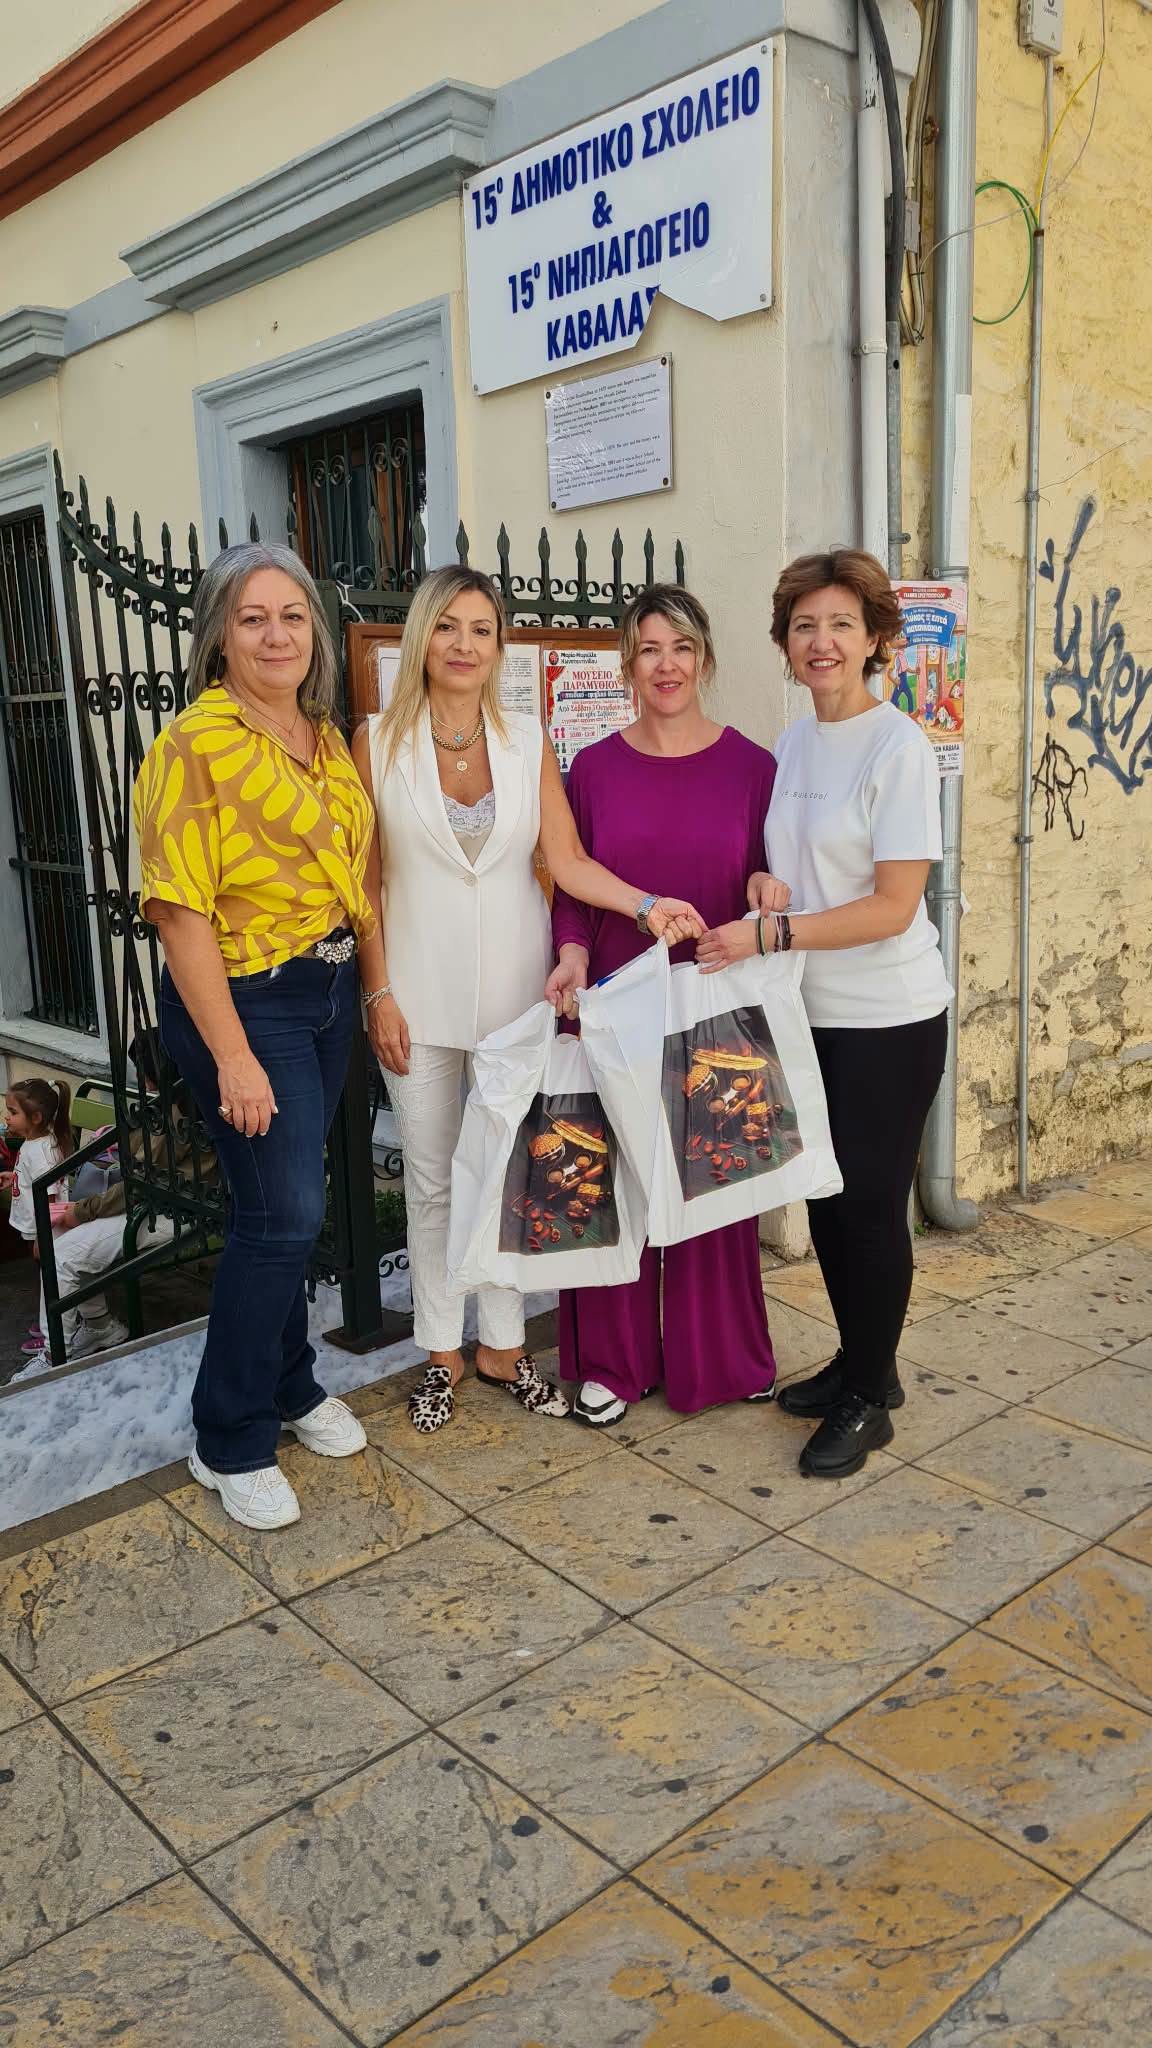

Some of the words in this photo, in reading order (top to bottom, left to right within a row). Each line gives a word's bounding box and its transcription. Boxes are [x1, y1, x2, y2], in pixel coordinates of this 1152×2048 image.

[510, 122, 634, 215] ΔΗΜΟΤΙΚΟ
[642, 66, 760, 159] ΣΧΟΛΕΙΟ
[592, 190, 613, 229] &
[548, 202, 710, 301] ΝΗΠΙΑΓΩΓΕΙΟ
[563, 681, 619, 690] ΠΑΡΑΜΥΘΙΟΥ
[572, 671, 612, 680] ΜΟΥΣΕΙΟ
